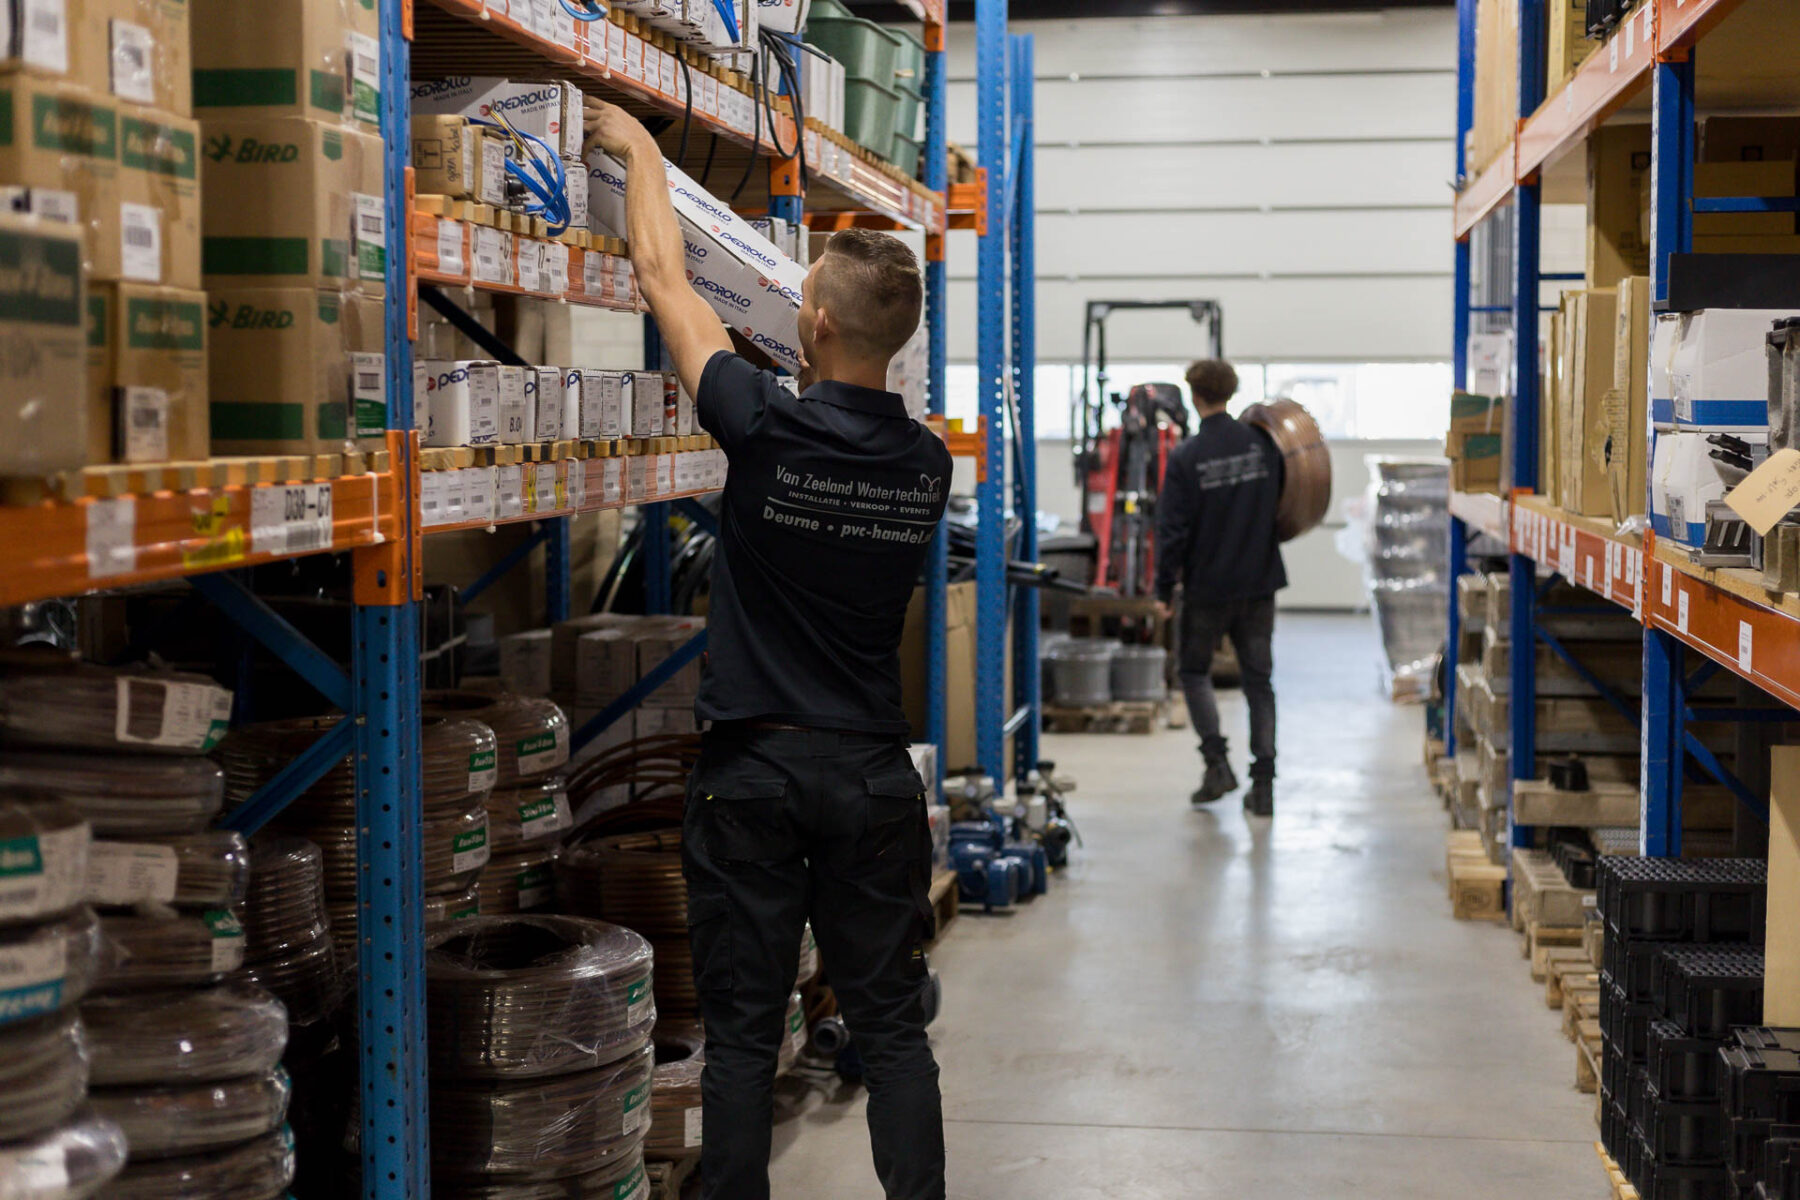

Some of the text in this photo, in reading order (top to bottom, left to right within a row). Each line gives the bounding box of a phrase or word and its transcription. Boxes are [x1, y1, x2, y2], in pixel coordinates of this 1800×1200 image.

[492, 87, 559, 113] PEDROLLO
[521, 106, 538, 114] MADE
[235, 138, 298, 164] BIRD
[675, 187, 732, 222] PEDROLLO
[720, 232, 777, 267] PEDROLLO
[693, 276, 752, 308] PEDROLLO
[713, 295, 728, 306] MADE
[734, 304, 748, 315] ITALY
[232, 304, 295, 329] BIRD
[773, 352, 787, 363] MADE
[776, 464, 800, 486] Van
[803, 473, 853, 496] Zeeland
[788, 490, 930, 516] INSTALLATIE VERKOOP EVENTS
[763, 505, 820, 531] Deurne
